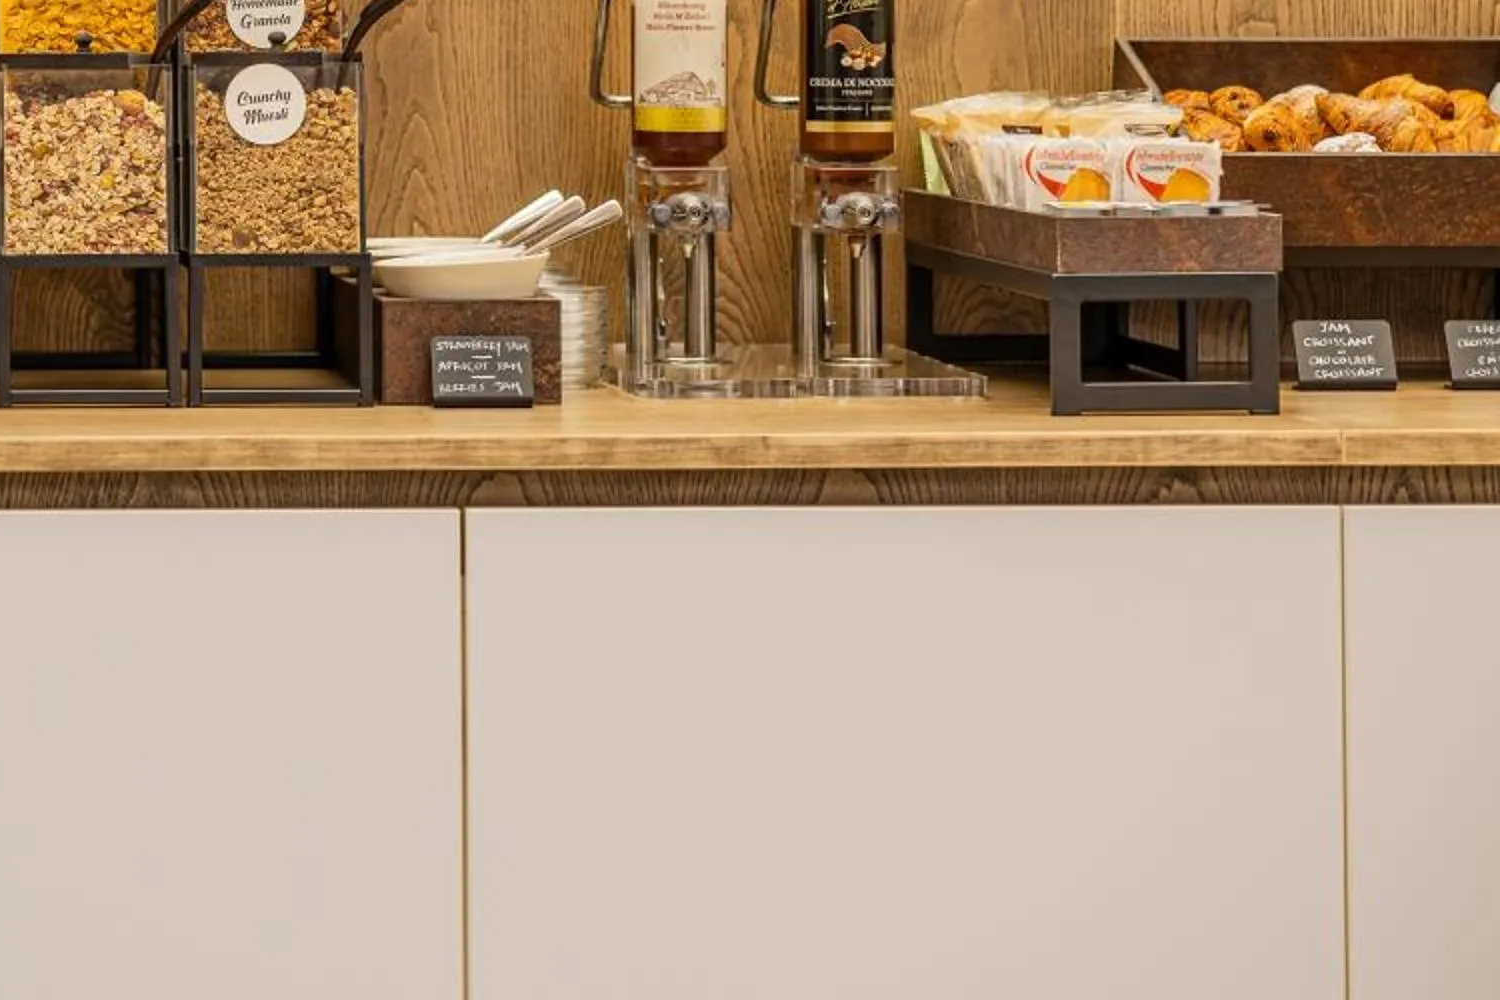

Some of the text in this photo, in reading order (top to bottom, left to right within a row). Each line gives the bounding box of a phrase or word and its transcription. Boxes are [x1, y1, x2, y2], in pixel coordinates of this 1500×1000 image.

[240, 13, 291, 29] Granola
[237, 89, 291, 106] Crunchy
[243, 107, 289, 125] Muesli
[1319, 322, 1351, 334] JAM
[435, 341, 529, 356] STRAWBERRY JAM
[1303, 335, 1375, 348] CROISSANT
[437, 361, 523, 374] APRICOT JAM
[1308, 355, 1376, 366] CHOCOLATE
[1315, 367, 1385, 379] CROISSANT
[494, 381, 524, 397] JAM
